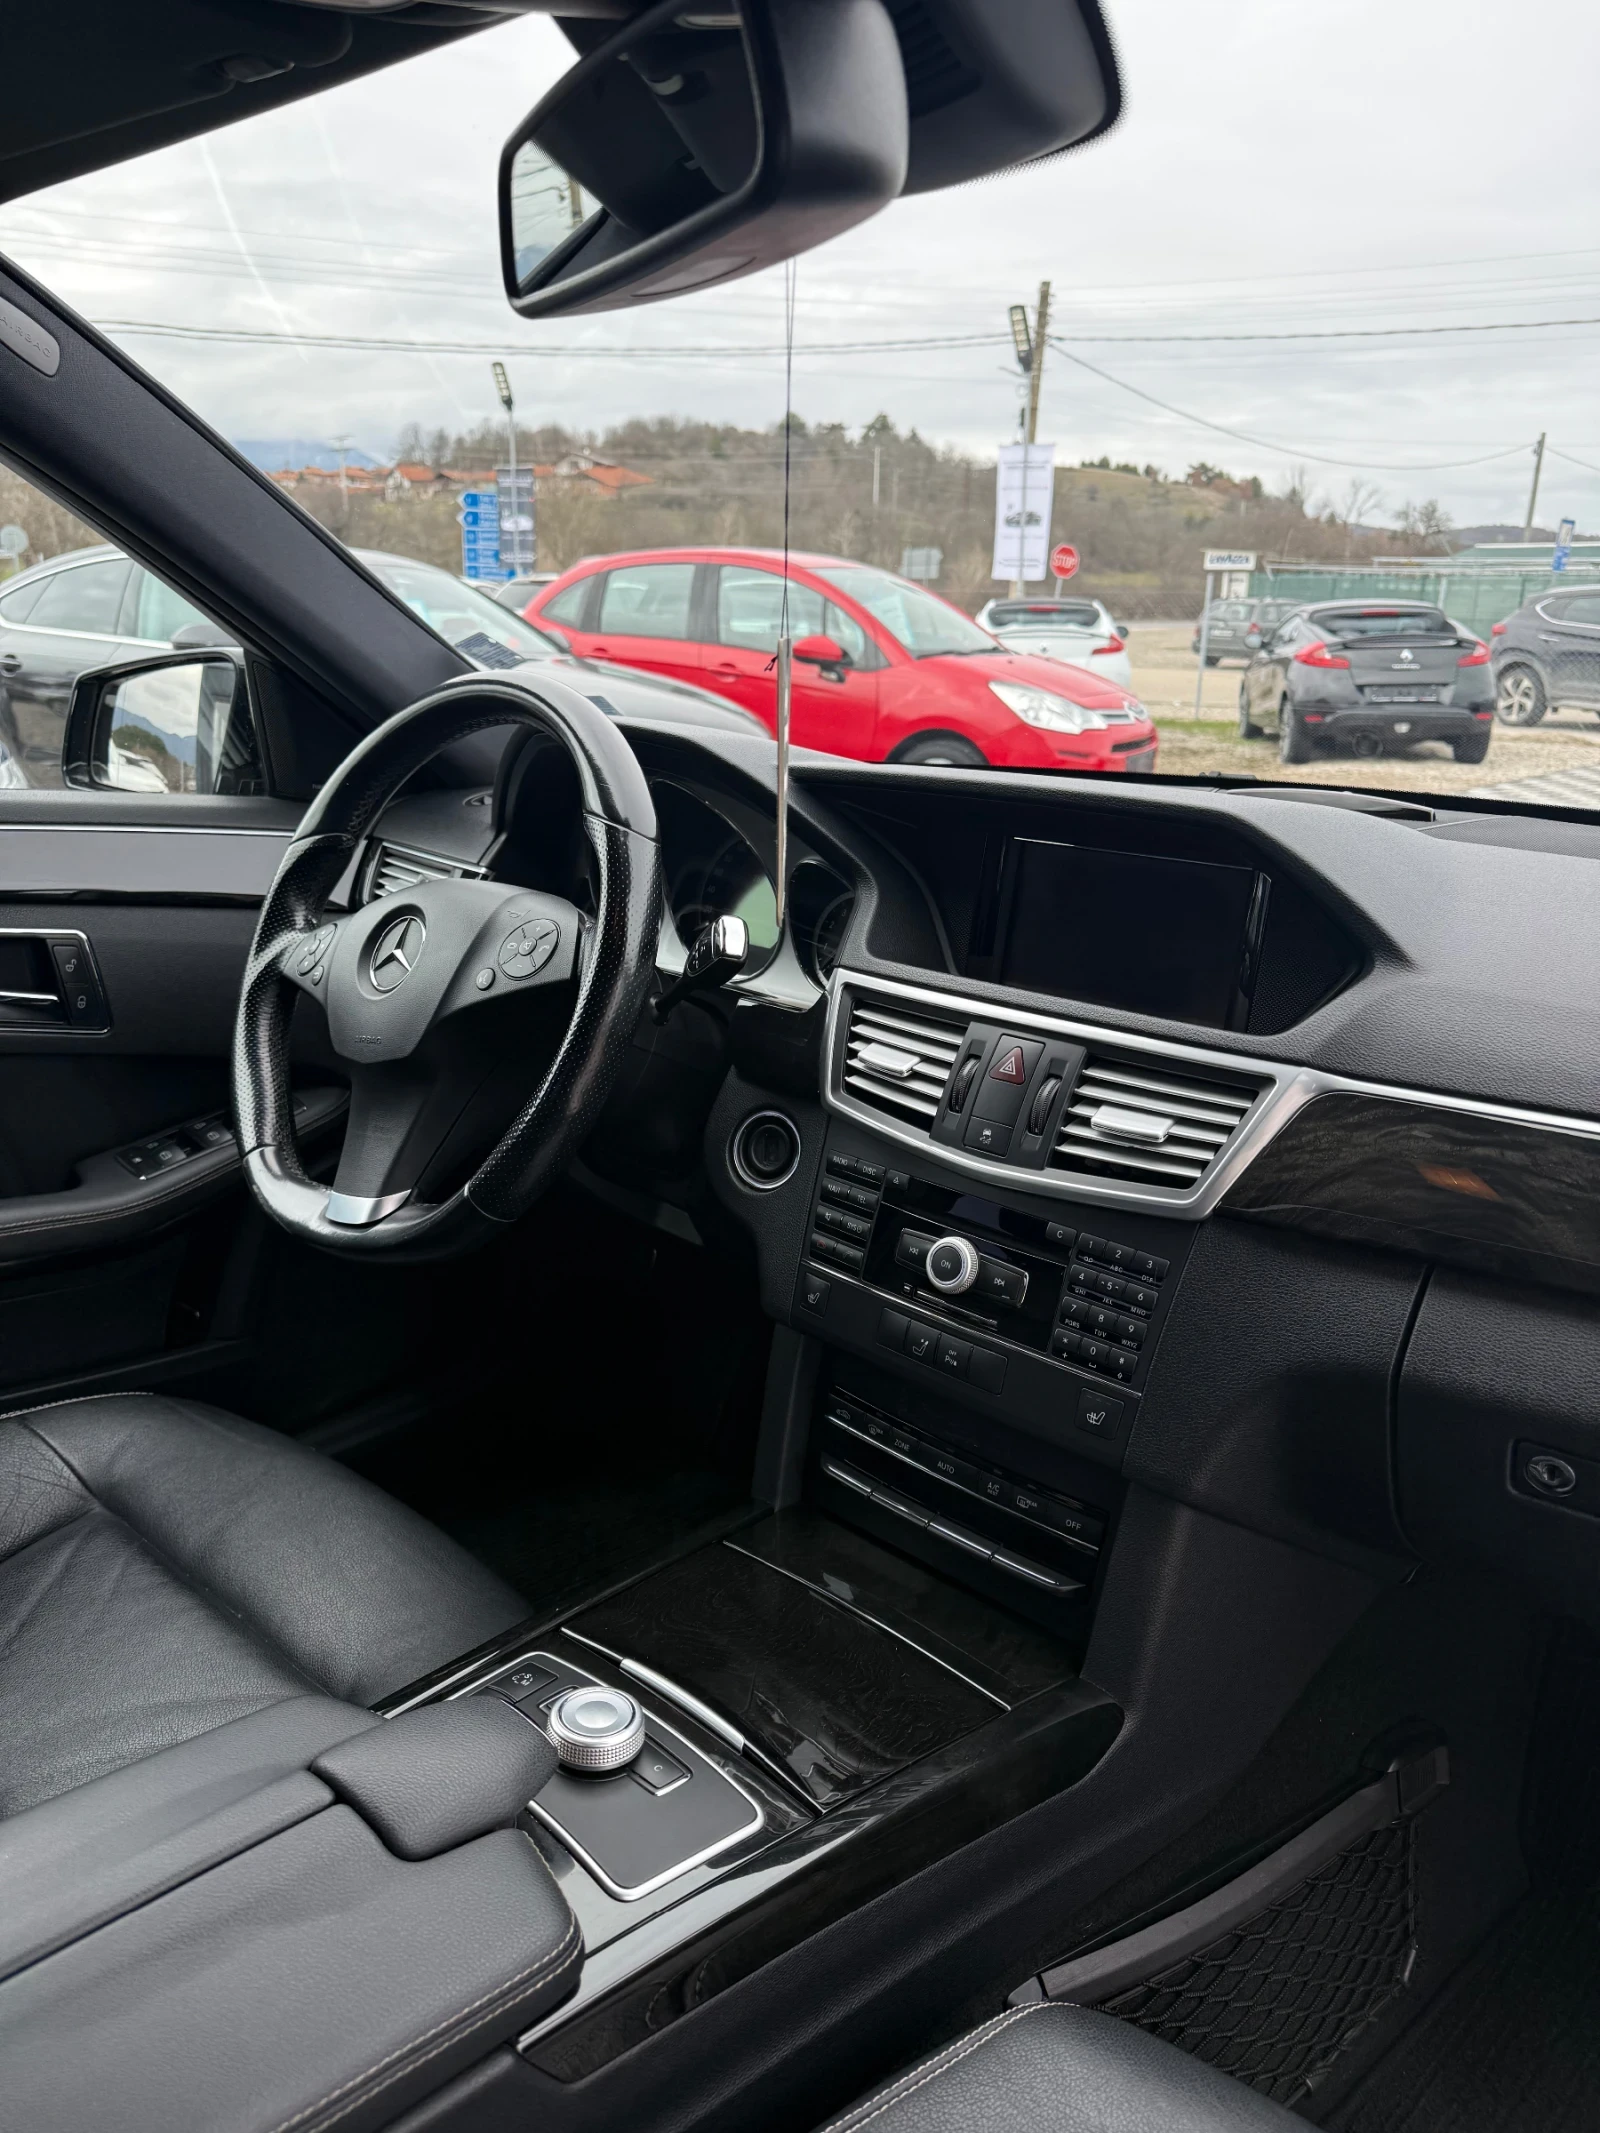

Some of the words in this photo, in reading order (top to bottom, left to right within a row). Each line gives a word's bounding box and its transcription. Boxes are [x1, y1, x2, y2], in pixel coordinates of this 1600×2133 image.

[862, 1165, 877, 1176] DISC
[857, 1194, 867, 1204] TEL
[1056, 1230, 1063, 1238] C
[1115, 1249, 1122, 1258] 2
[940, 1259, 952, 1269] ON
[1109, 1264, 1124, 1273] ABC
[1146, 1260, 1153, 1269] 3
[1078, 1272, 1085, 1281] 4
[1137, 1292, 1144, 1301] 6
[1070, 1304, 1077, 1313] 7
[1130, 1306, 1146, 1317] MNO
[1064, 1318, 1080, 1329] PQRS
[1097, 1314, 1105, 1323] 8
[1094, 1328, 1107, 1338] TUV
[1128, 1324, 1135, 1333] 9
[1121, 1338, 1138, 1349] WXYZ
[893, 1438, 911, 1452] ZONE
[936, 1460, 955, 1475] AUTO
[986, 1481, 1000, 1493] A/C
[1065, 1519, 1082, 1531] OFF
